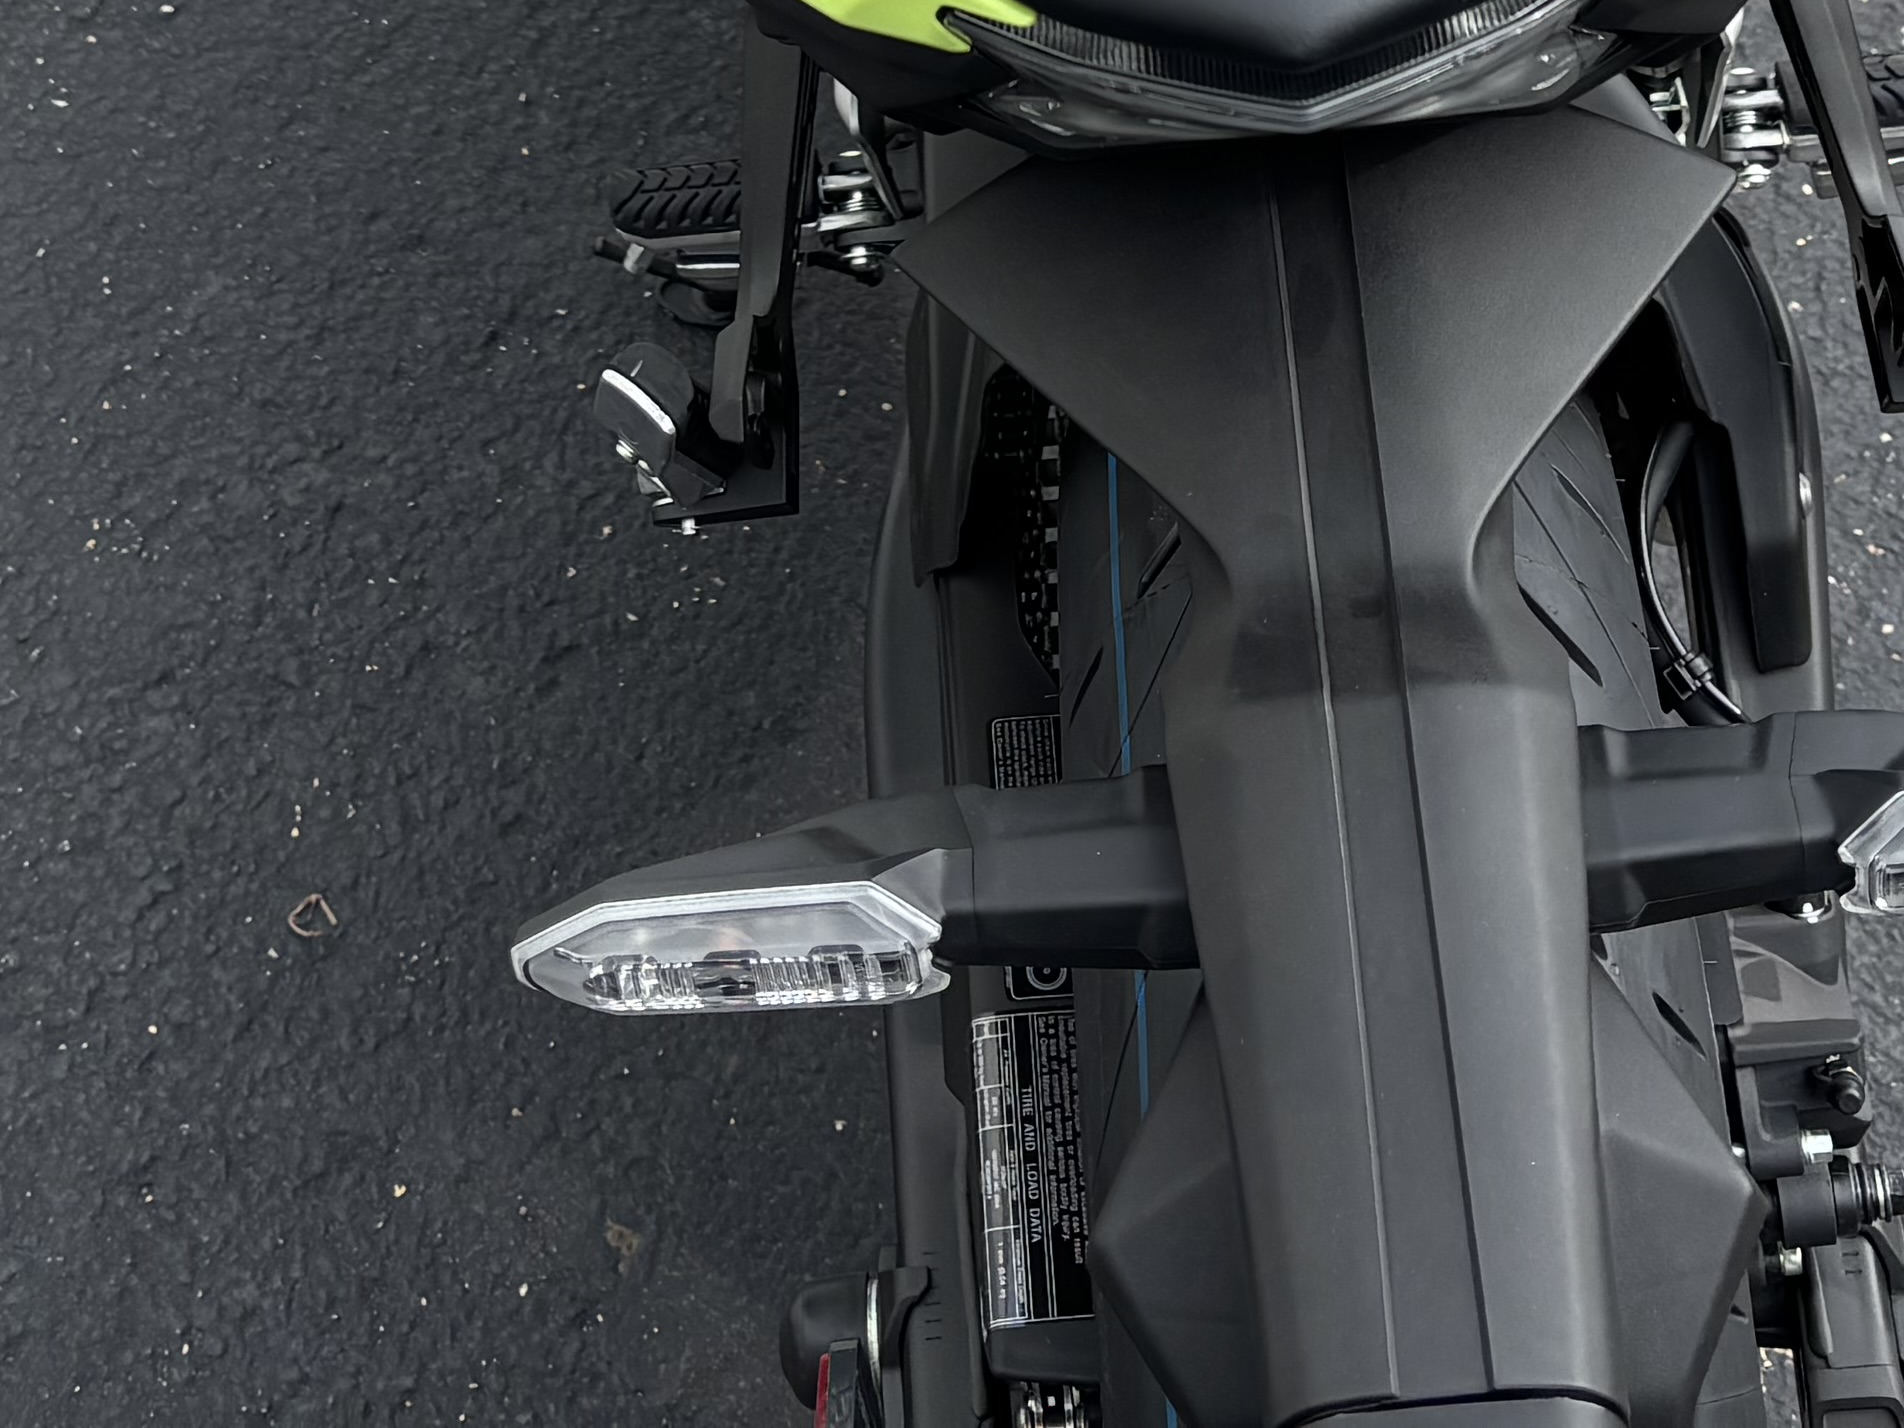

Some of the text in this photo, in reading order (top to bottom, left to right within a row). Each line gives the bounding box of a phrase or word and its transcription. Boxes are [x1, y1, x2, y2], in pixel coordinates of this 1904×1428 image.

[1021, 1085, 1042, 1242] TIRE AND LOAD DATA
